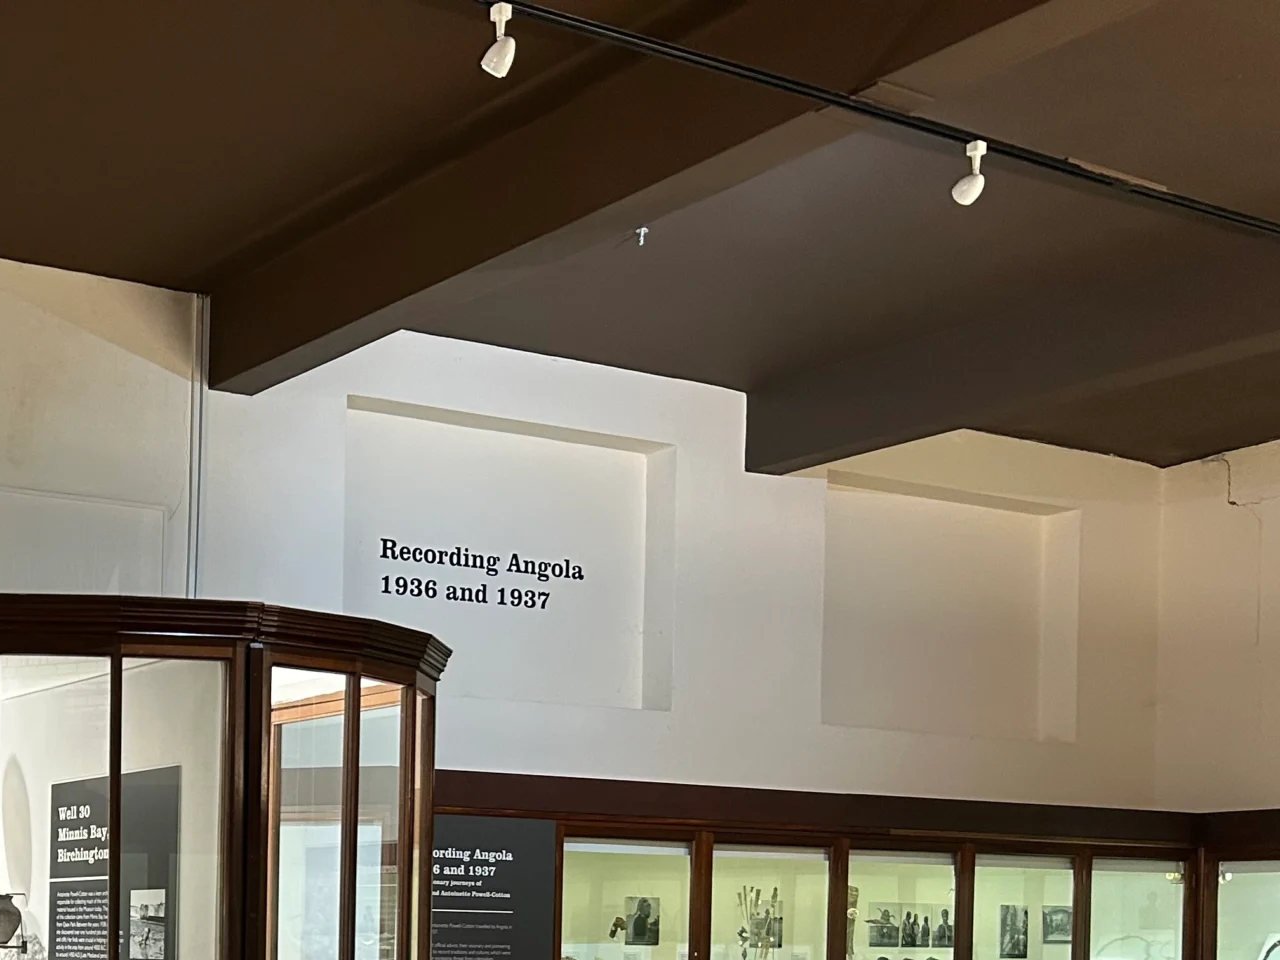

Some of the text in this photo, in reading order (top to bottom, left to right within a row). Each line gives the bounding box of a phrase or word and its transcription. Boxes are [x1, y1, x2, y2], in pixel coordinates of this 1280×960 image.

[380, 538, 584, 581] Recording Angola
[381, 575, 550, 609] 1936 and 1937
[58, 805, 91, 820] Well 30
[58, 826, 88, 842] Minnis
[57, 847, 109, 864] Birchington
[433, 848, 513, 862] ording Angola
[443, 865, 464, 875] and
[468, 866, 496, 876] 1937
